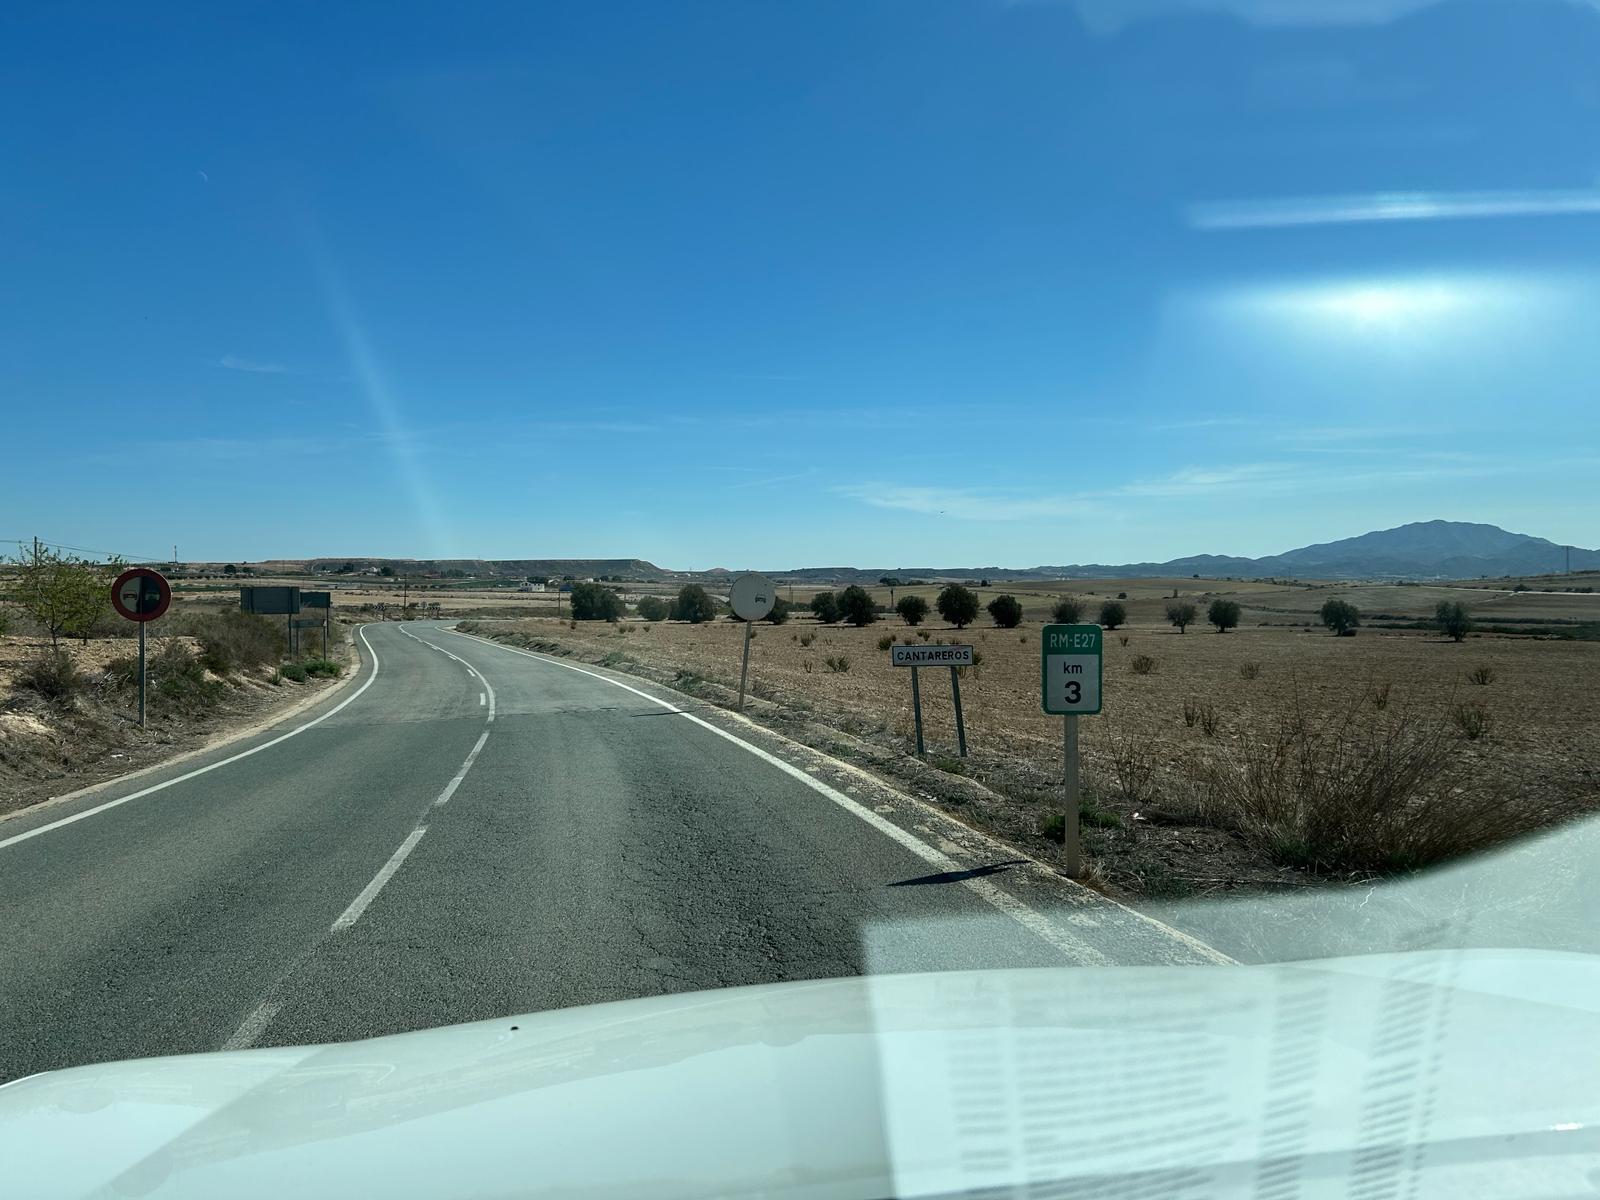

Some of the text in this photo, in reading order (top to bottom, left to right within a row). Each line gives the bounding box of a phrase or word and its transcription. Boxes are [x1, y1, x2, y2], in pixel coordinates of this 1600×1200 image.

[896, 650, 970, 661] CANTAREROS
[1063, 661, 1083, 674] km
[1064, 680, 1082, 704] 3
